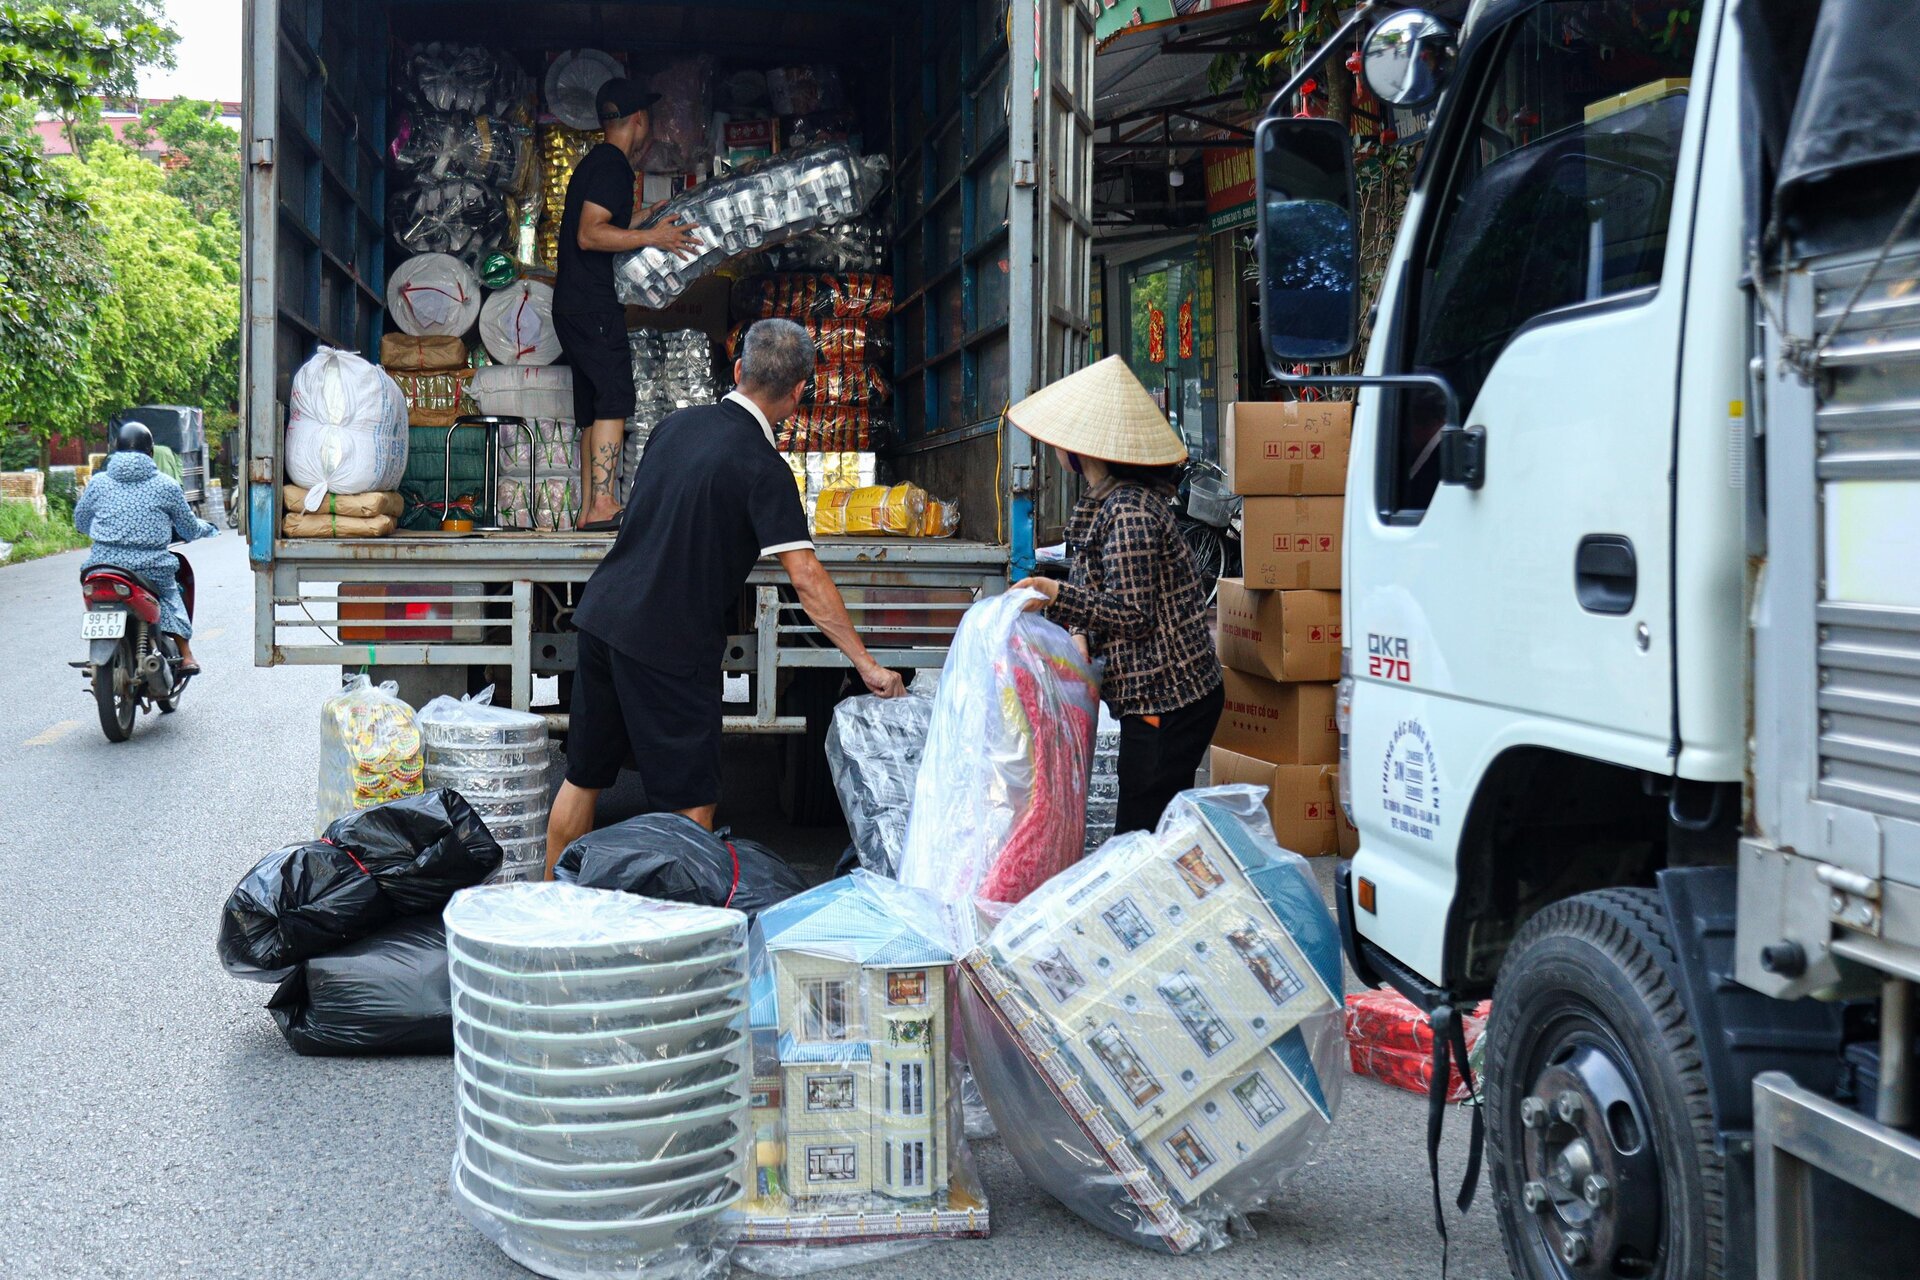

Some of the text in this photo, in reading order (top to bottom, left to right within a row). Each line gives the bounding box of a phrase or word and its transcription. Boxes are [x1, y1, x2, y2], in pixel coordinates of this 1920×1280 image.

[88, 613, 120, 625] 99-F1
[83, 625, 122, 637] 465.67
[1368, 633, 1409, 660] QKR
[1369, 655, 1411, 683] 270
